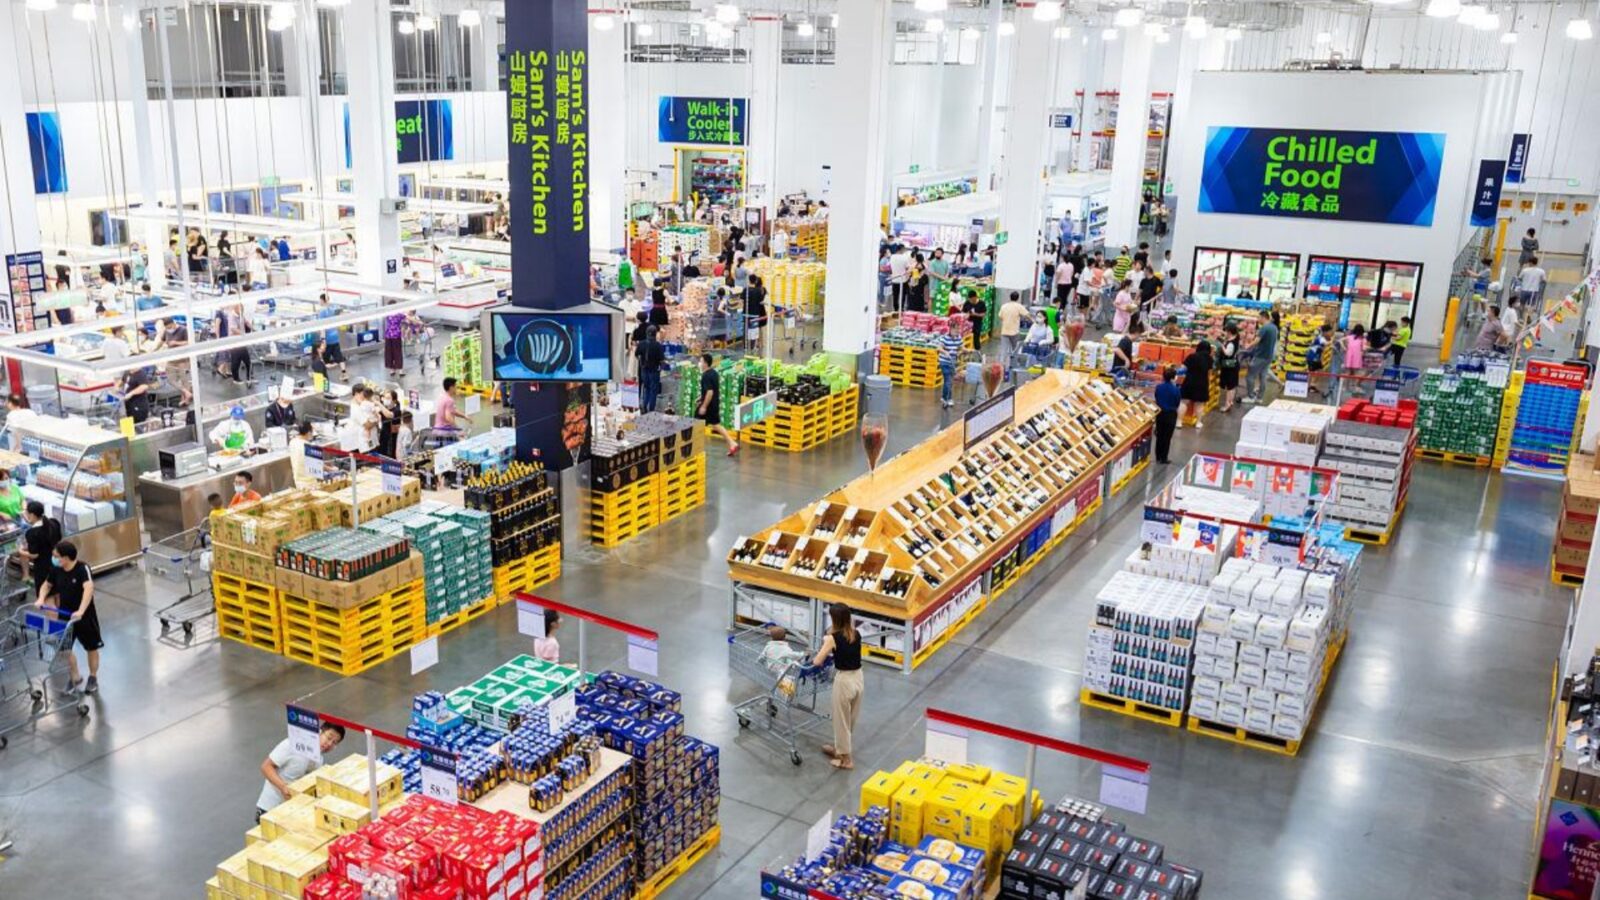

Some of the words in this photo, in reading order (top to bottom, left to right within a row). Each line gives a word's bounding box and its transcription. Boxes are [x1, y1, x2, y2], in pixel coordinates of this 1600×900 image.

[509, 50, 528, 144] 山姆厨房
[529, 50, 550, 128] Sam's
[555, 50, 570, 145] 山姆厨房
[571, 50, 586, 127] Sam's
[687, 101, 739, 116] Walk-in
[396, 114, 423, 134] eat
[687, 115, 731, 130] Cooler
[1263, 162, 1342, 190] Food
[1266, 135, 1378, 165] Chilled
[531, 134, 551, 235] Kitchen
[572, 132, 588, 232] Kitchen
[1260, 190, 1340, 214] 冷藏食品
